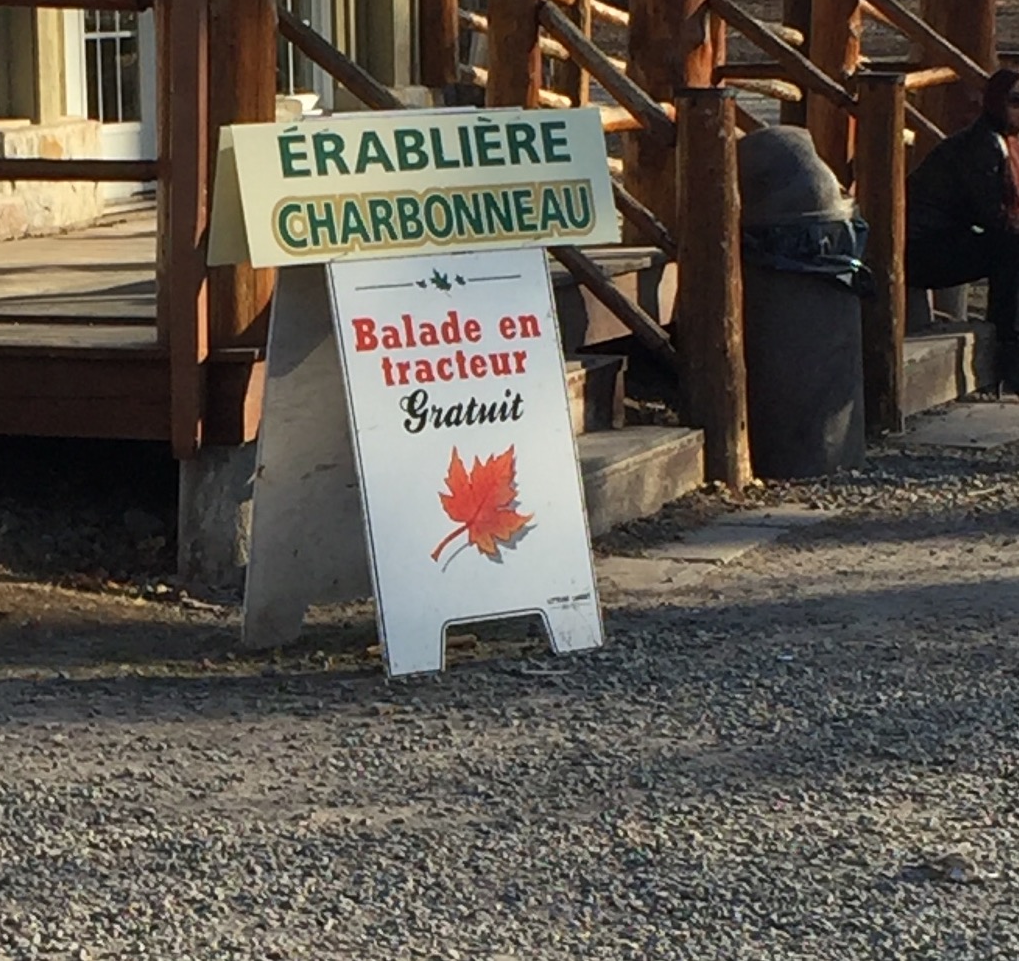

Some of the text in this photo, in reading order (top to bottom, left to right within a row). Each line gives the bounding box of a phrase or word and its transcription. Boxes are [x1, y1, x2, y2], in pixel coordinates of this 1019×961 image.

[277, 117, 572, 178] ÉRABLIÈRE
[277, 184, 593, 250] CHARBONNEAU
[352, 311, 542, 352] Balade en
[381, 350, 527, 386] tracteur
[400, 389, 524, 433] Gratuit
